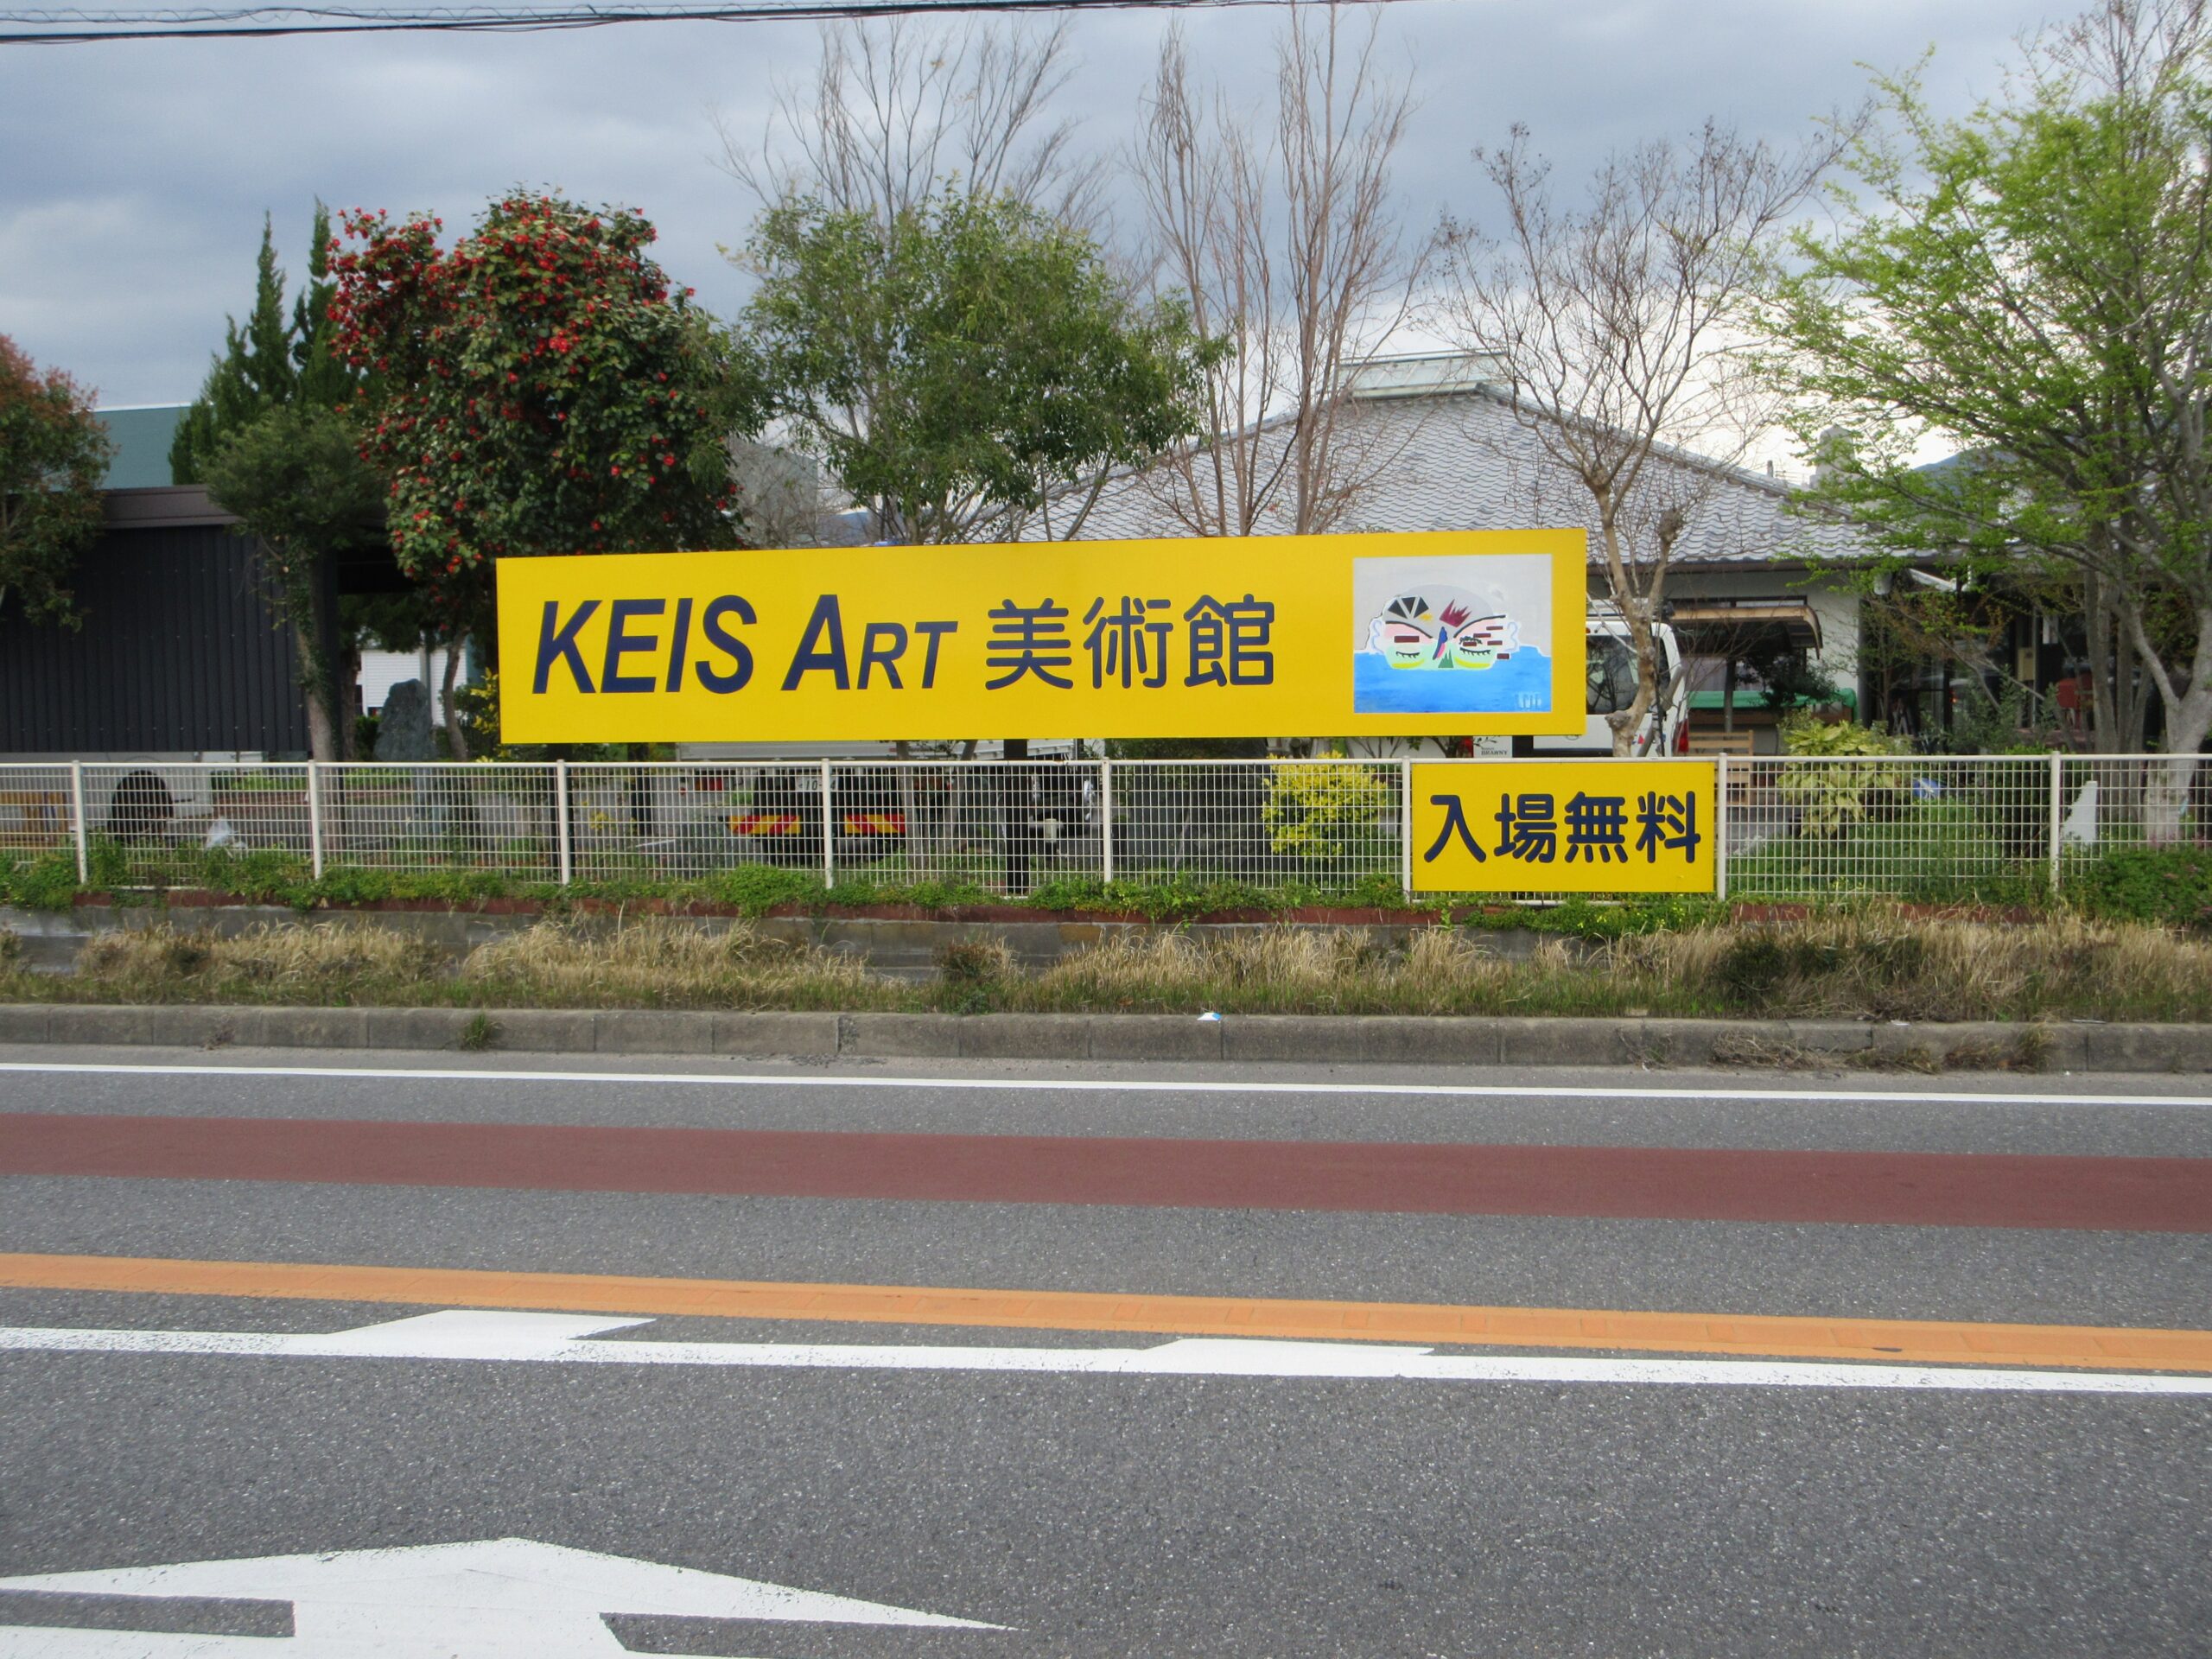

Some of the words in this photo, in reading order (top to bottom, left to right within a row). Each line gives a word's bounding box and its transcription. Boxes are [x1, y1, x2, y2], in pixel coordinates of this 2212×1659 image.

[533, 594, 757, 695] KEIS
[781, 594, 958, 691] ART
[985, 594, 1275, 690] 美術館
[1423, 791, 1701, 864] 入場無料
